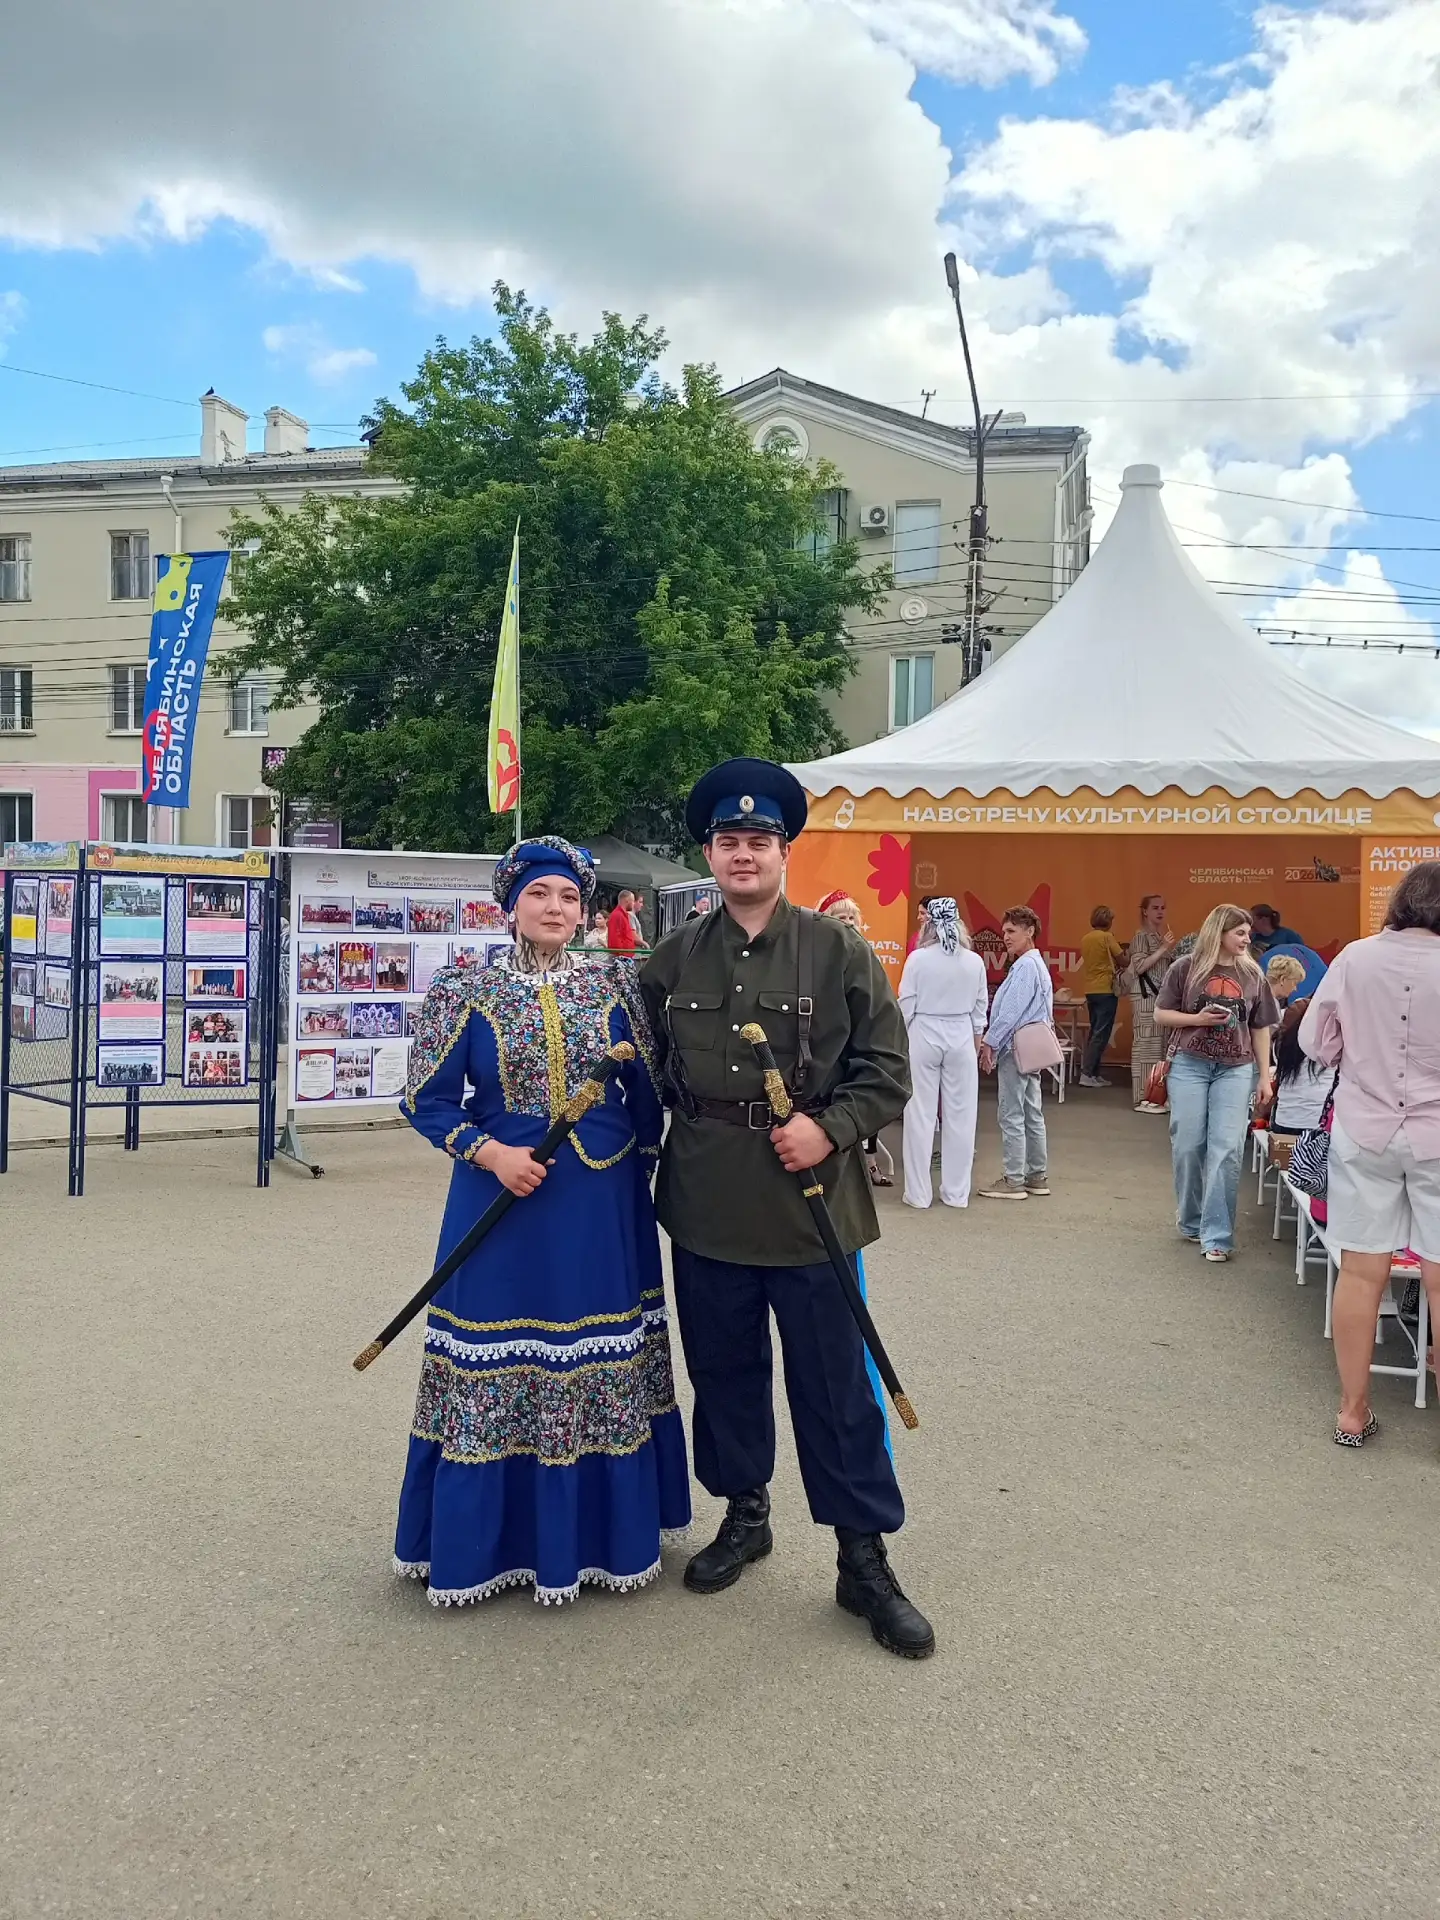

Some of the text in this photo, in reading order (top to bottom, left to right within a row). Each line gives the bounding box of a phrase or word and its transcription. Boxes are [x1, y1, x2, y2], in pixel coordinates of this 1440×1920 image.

[151, 583, 203, 791] ЧЕЛЯБИНСКАЯ
[165, 659, 196, 794] ОБЛАСТЬ
[903, 803, 1372, 826] НАВСТРЕЧУ КУЛЬТУРНОЙ СТОЛИЦЕ
[1189, 867, 1274, 876] ЧЕЛЯБИНСКАЯ
[1285, 869, 1314, 880] 2026
